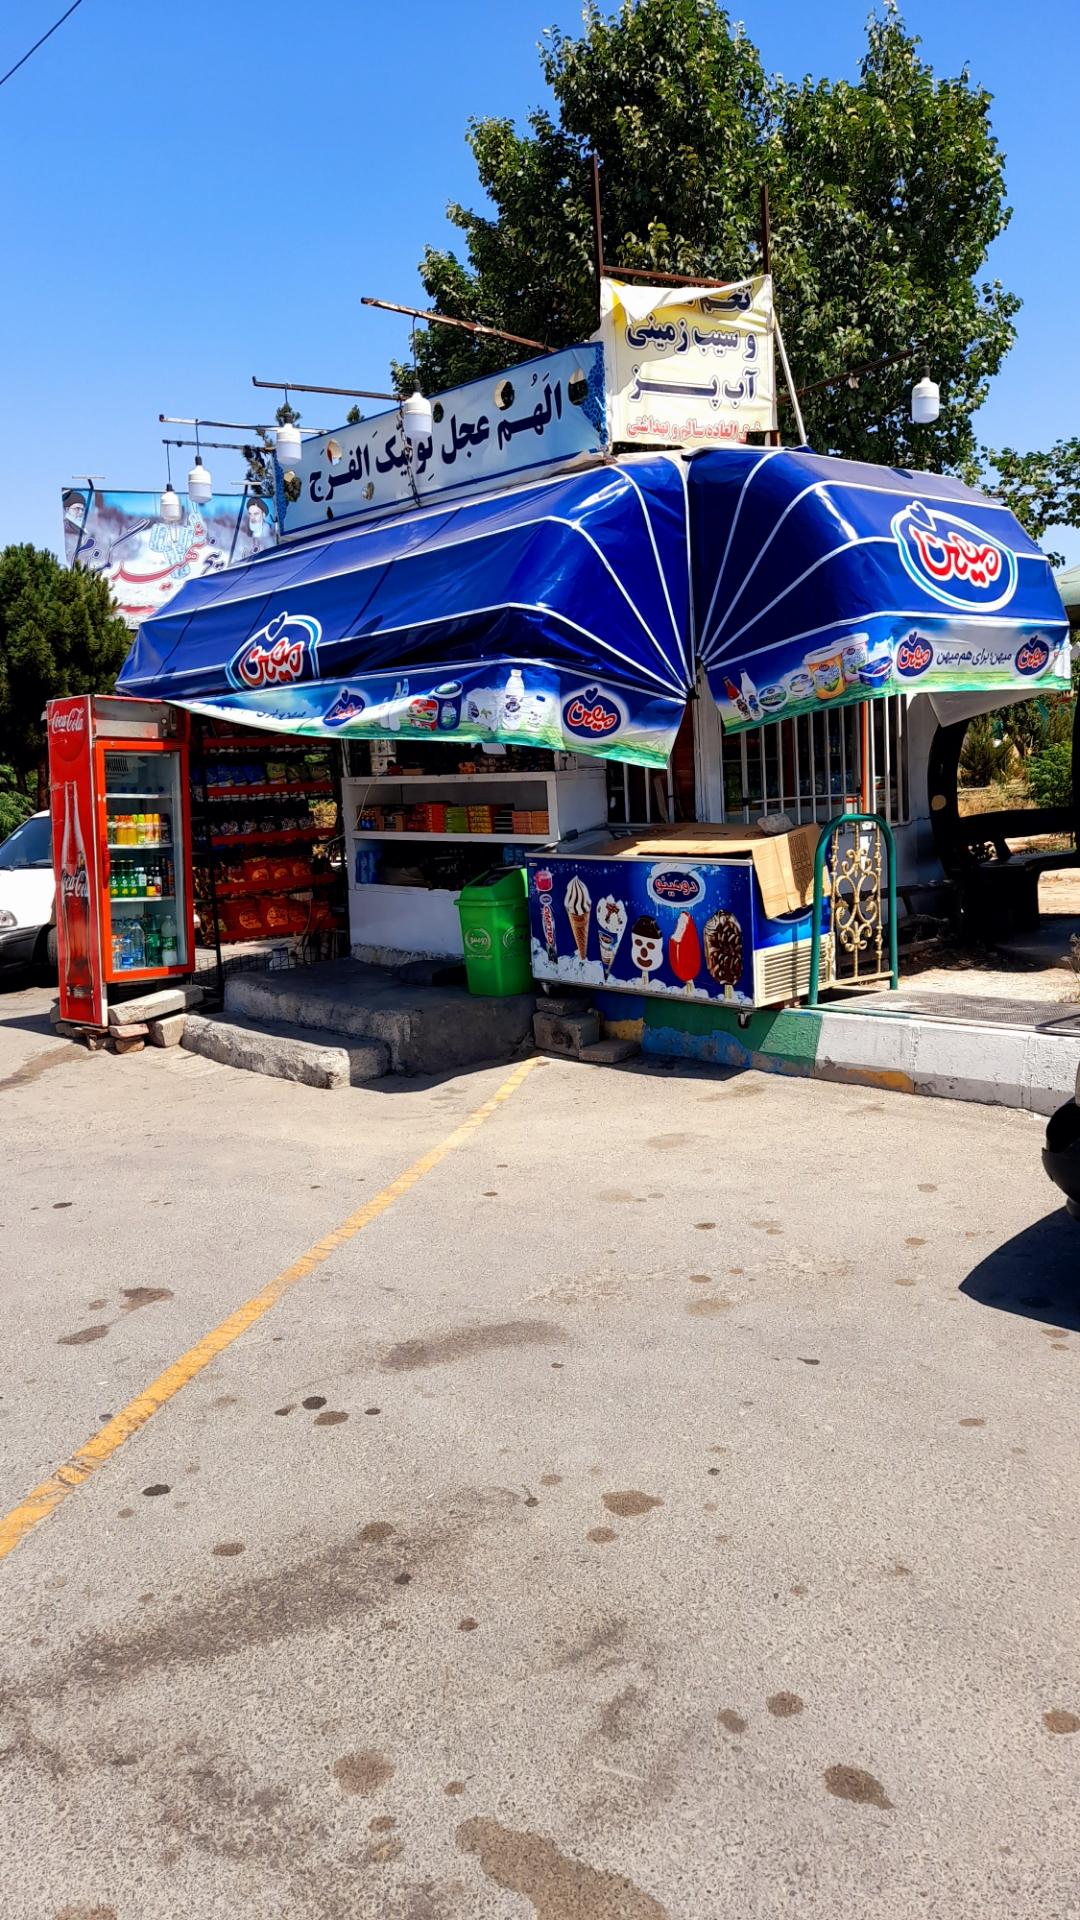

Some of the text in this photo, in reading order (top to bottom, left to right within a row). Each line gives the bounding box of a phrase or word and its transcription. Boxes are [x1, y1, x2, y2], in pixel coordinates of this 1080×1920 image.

[627, 316, 757, 359] و سیب زمینی
[724, 371, 757, 407] آب
[441, 414, 489, 465] عجل
[908, 524, 1002, 588] میهن
[238, 636, 305, 688] میهن
[897, 644, 931, 671] میهن
[567, 699, 617, 733] میهن
